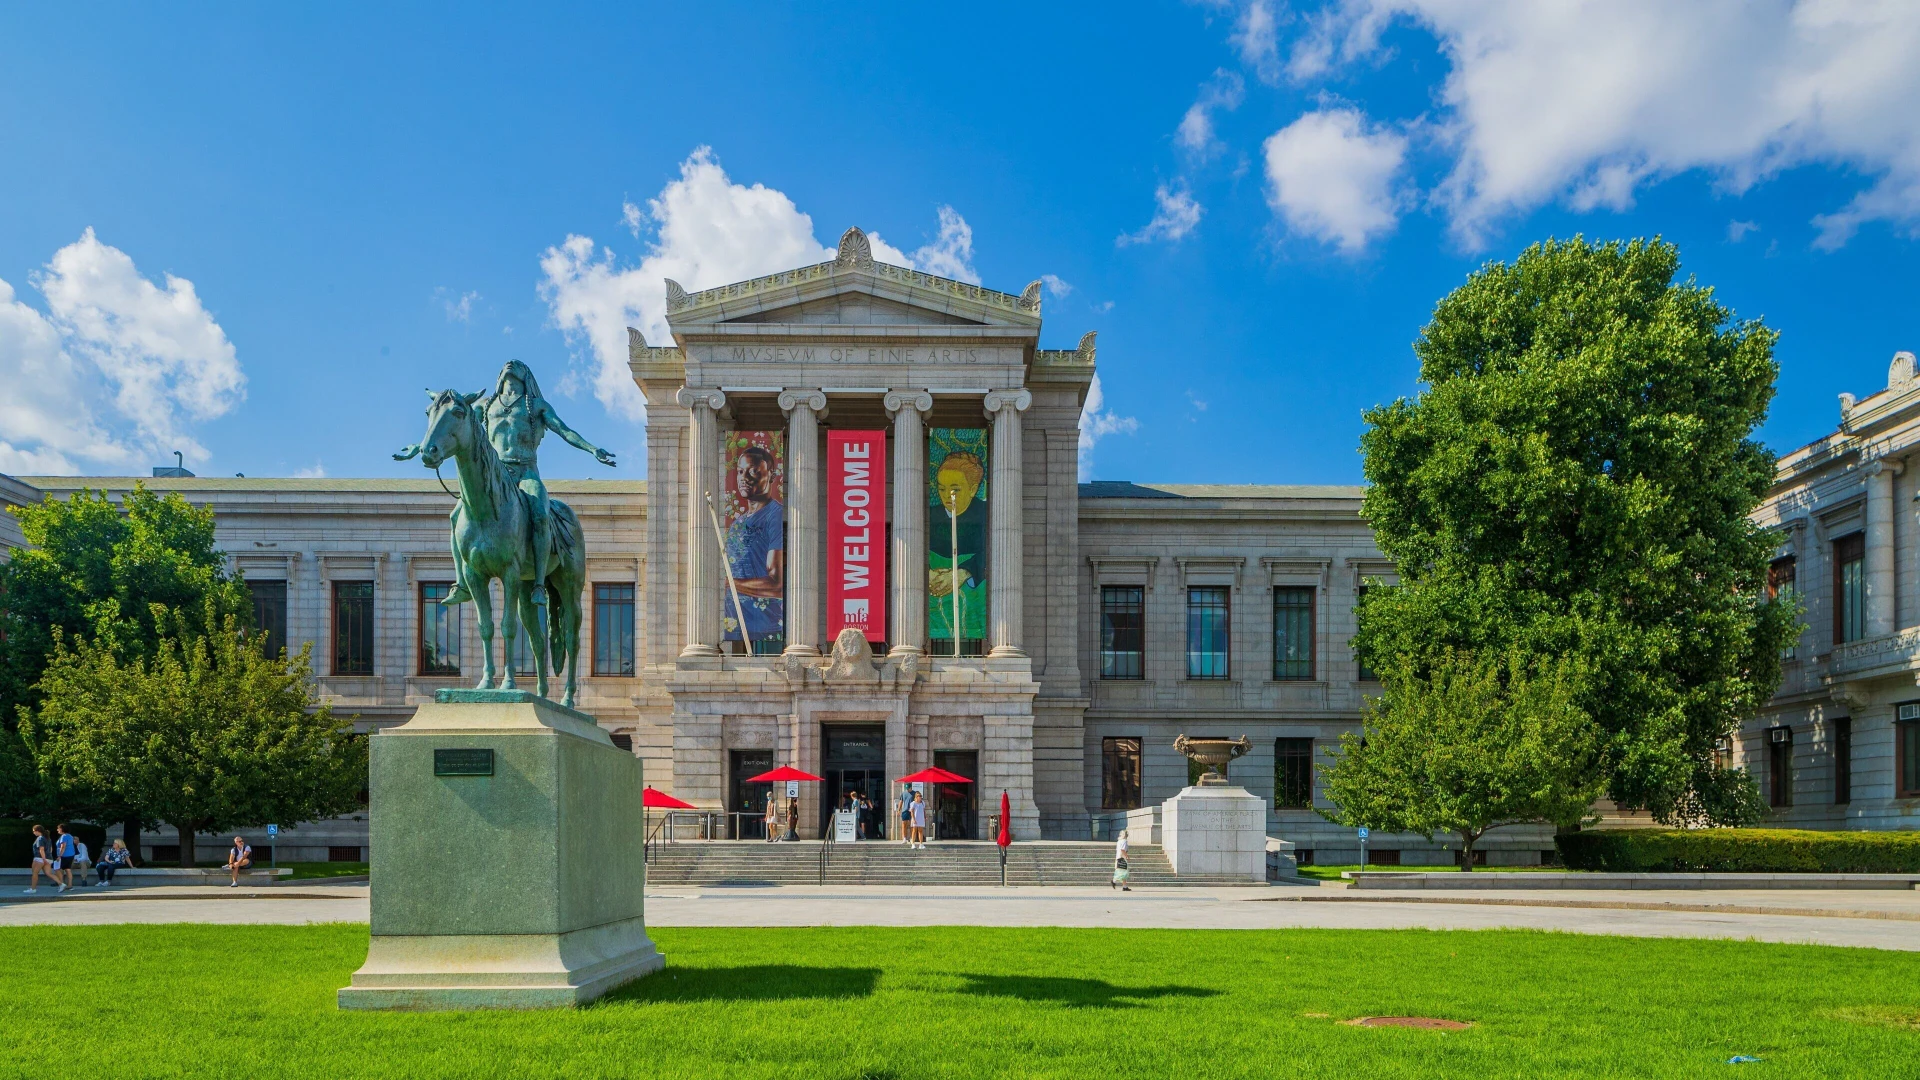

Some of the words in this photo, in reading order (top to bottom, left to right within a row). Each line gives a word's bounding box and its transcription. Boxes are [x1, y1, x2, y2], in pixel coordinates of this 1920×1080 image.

[732, 347, 816, 362] MVSEVM
[830, 347, 854, 362] OF
[869, 347, 915, 362] FINE
[928, 347, 977, 362] ARTS
[843, 442, 870, 591] WELCOME
[843, 607, 869, 622] mfa
